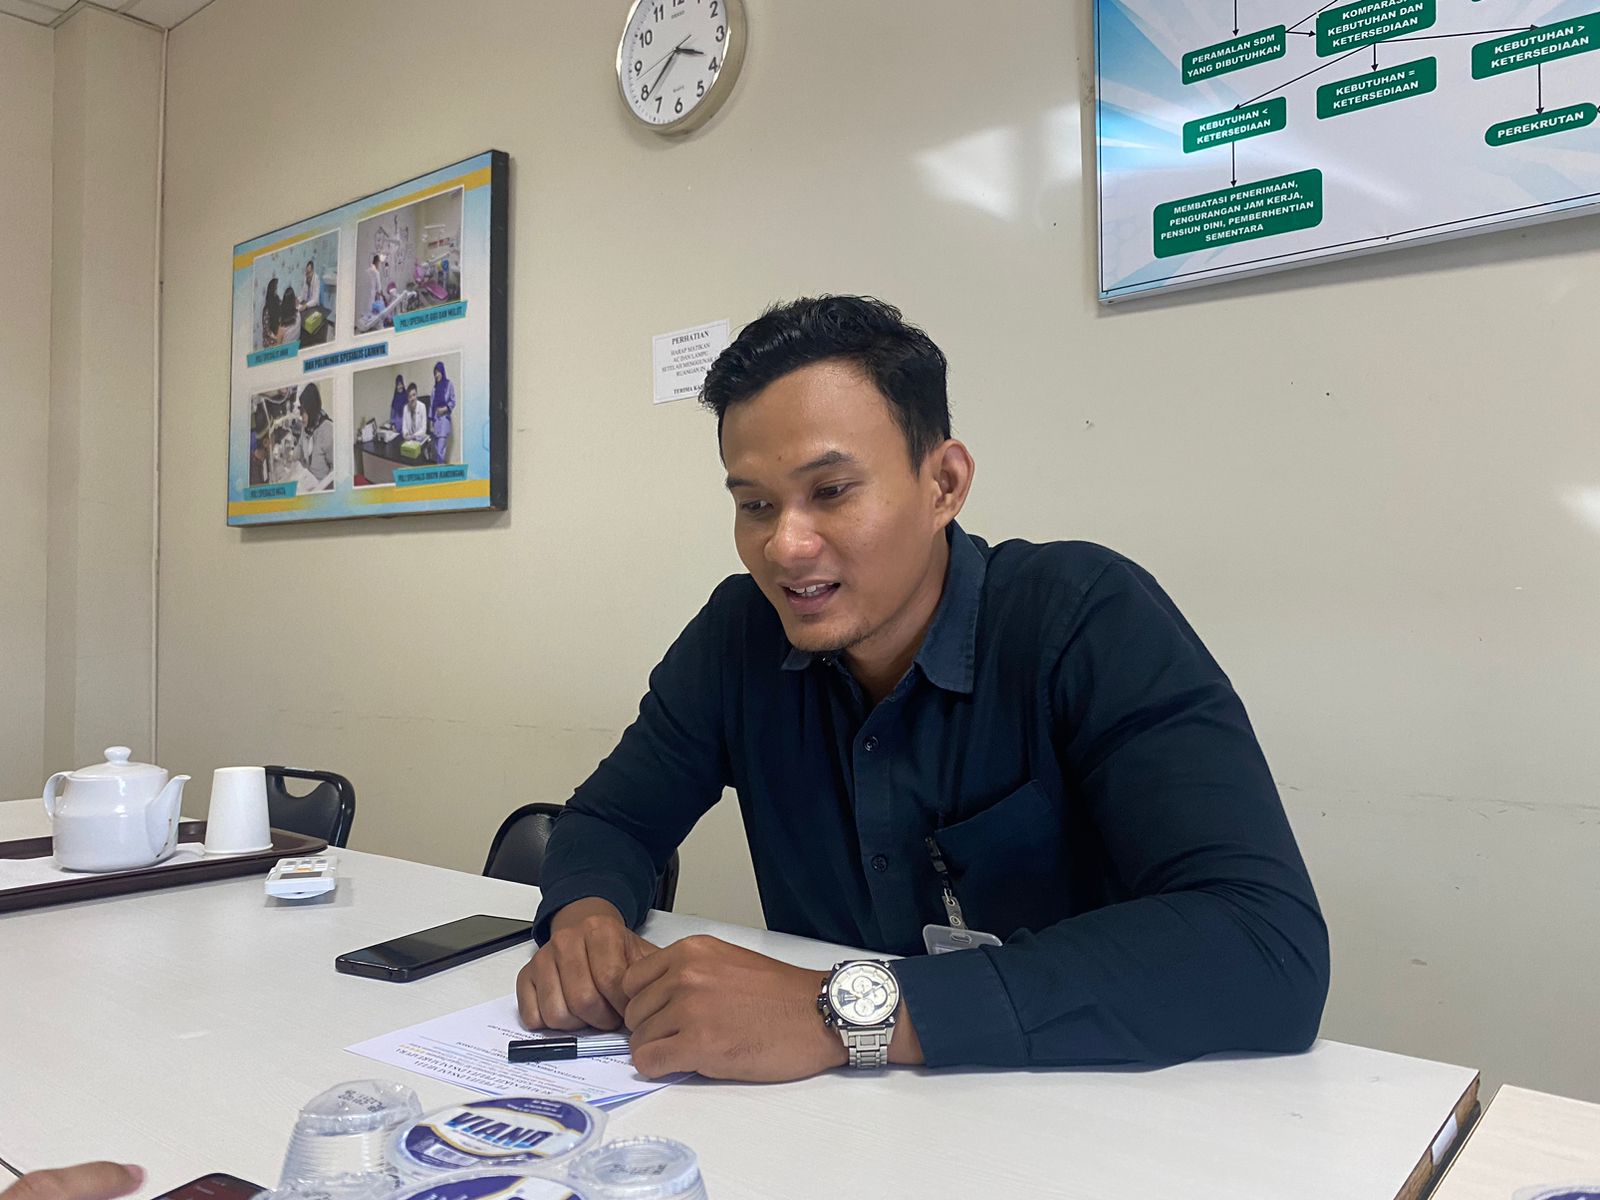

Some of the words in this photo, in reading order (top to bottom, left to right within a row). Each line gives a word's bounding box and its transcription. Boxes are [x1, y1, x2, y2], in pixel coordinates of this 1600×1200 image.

[653, 4, 664, 22] 11
[709, 0, 718, 18] 2
[1327, 10, 1396, 36] KEBUTUHAN
[1400, 2, 1423, 16] DAN
[1342, 0, 1408, 20] KOMPARA
[639, 29, 653, 48] 10
[715, 25, 725, 42] 3
[1332, 17, 1418, 47] KETERSEDIAAN
[1494, 26, 1574, 54] KEBUTUHAN
[1187, 65, 1213, 78] YANG
[1215, 44, 1281, 70] DIBUTUHKAN
[1192, 41, 1251, 65] PERAMALAN
[1253, 34, 1275, 46] SDM
[1491, 36, 1589, 69] KETERSEDIAAN
[634, 60, 643, 77] 9
[708, 56, 718, 73] 4
[641, 84, 649, 101] 8
[696, 80, 704, 98] 5
[1333, 80, 1419, 109] KETERSEDIAAN
[1336, 71, 1405, 96] KEBUTUHAN
[655, 96, 663, 114] 7
[674, 97, 683, 114] 6
[1196, 119, 1271, 144] KETERSEDIAAN
[1199, 110, 1260, 132] KEBUTUHAN
[1497, 111, 1584, 138] PEREKRUTAN
[1173, 196, 1228, 215] MEMBATASI
[1230, 180, 1298, 202] PENERIMAAN,
[1160, 225, 1201, 240] PENSIUN
[1203, 220, 1226, 232] DINI,
[1228, 201, 1314, 226] PEMBERHENTIAN
[1169, 204, 1241, 227] PENGURANGAN
[1244, 199, 1264, 210] JAM
[1266, 192, 1303, 206] KERJA,
[1205, 223, 1264, 242] SEMENTARA
[671, 331, 709, 345] PERHATIAN
[445, 1112, 553, 1148] VIAND
